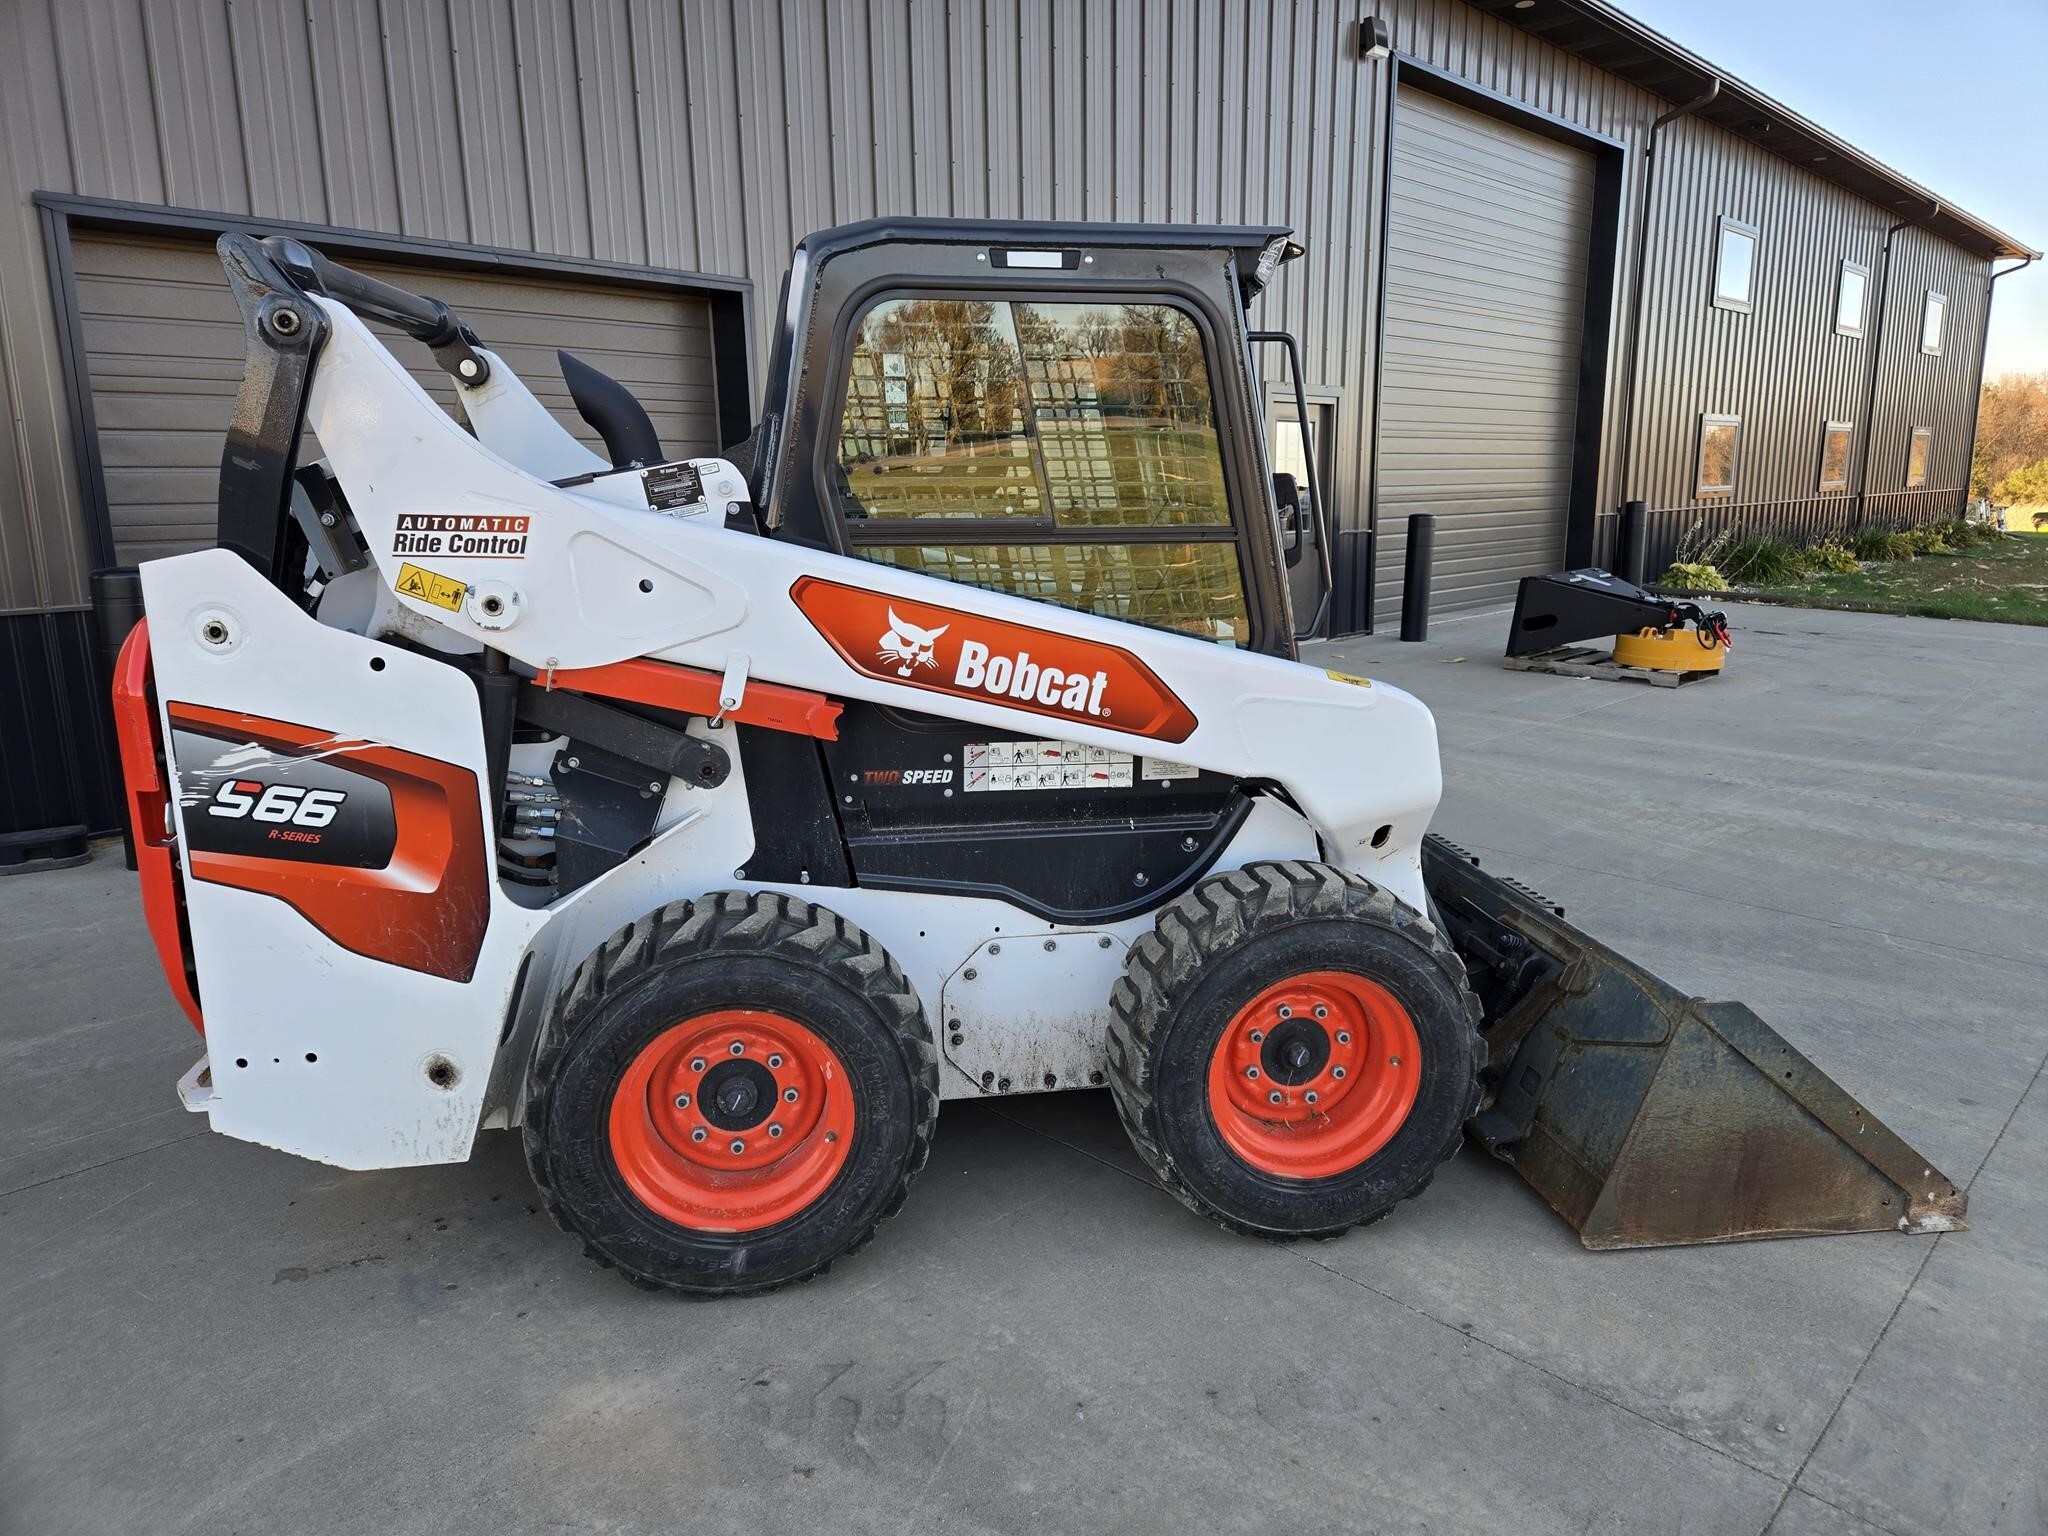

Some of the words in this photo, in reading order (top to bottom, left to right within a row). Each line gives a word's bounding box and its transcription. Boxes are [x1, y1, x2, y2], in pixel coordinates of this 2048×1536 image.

[401, 516, 525, 531] AUTOMATIC
[393, 534, 441, 553] Ride
[448, 535, 527, 554] Control
[863, 769, 902, 785] TWO
[902, 769, 954, 785] SPEED
[208, 780, 347, 827] S66
[268, 829, 321, 844] R-SERIES
